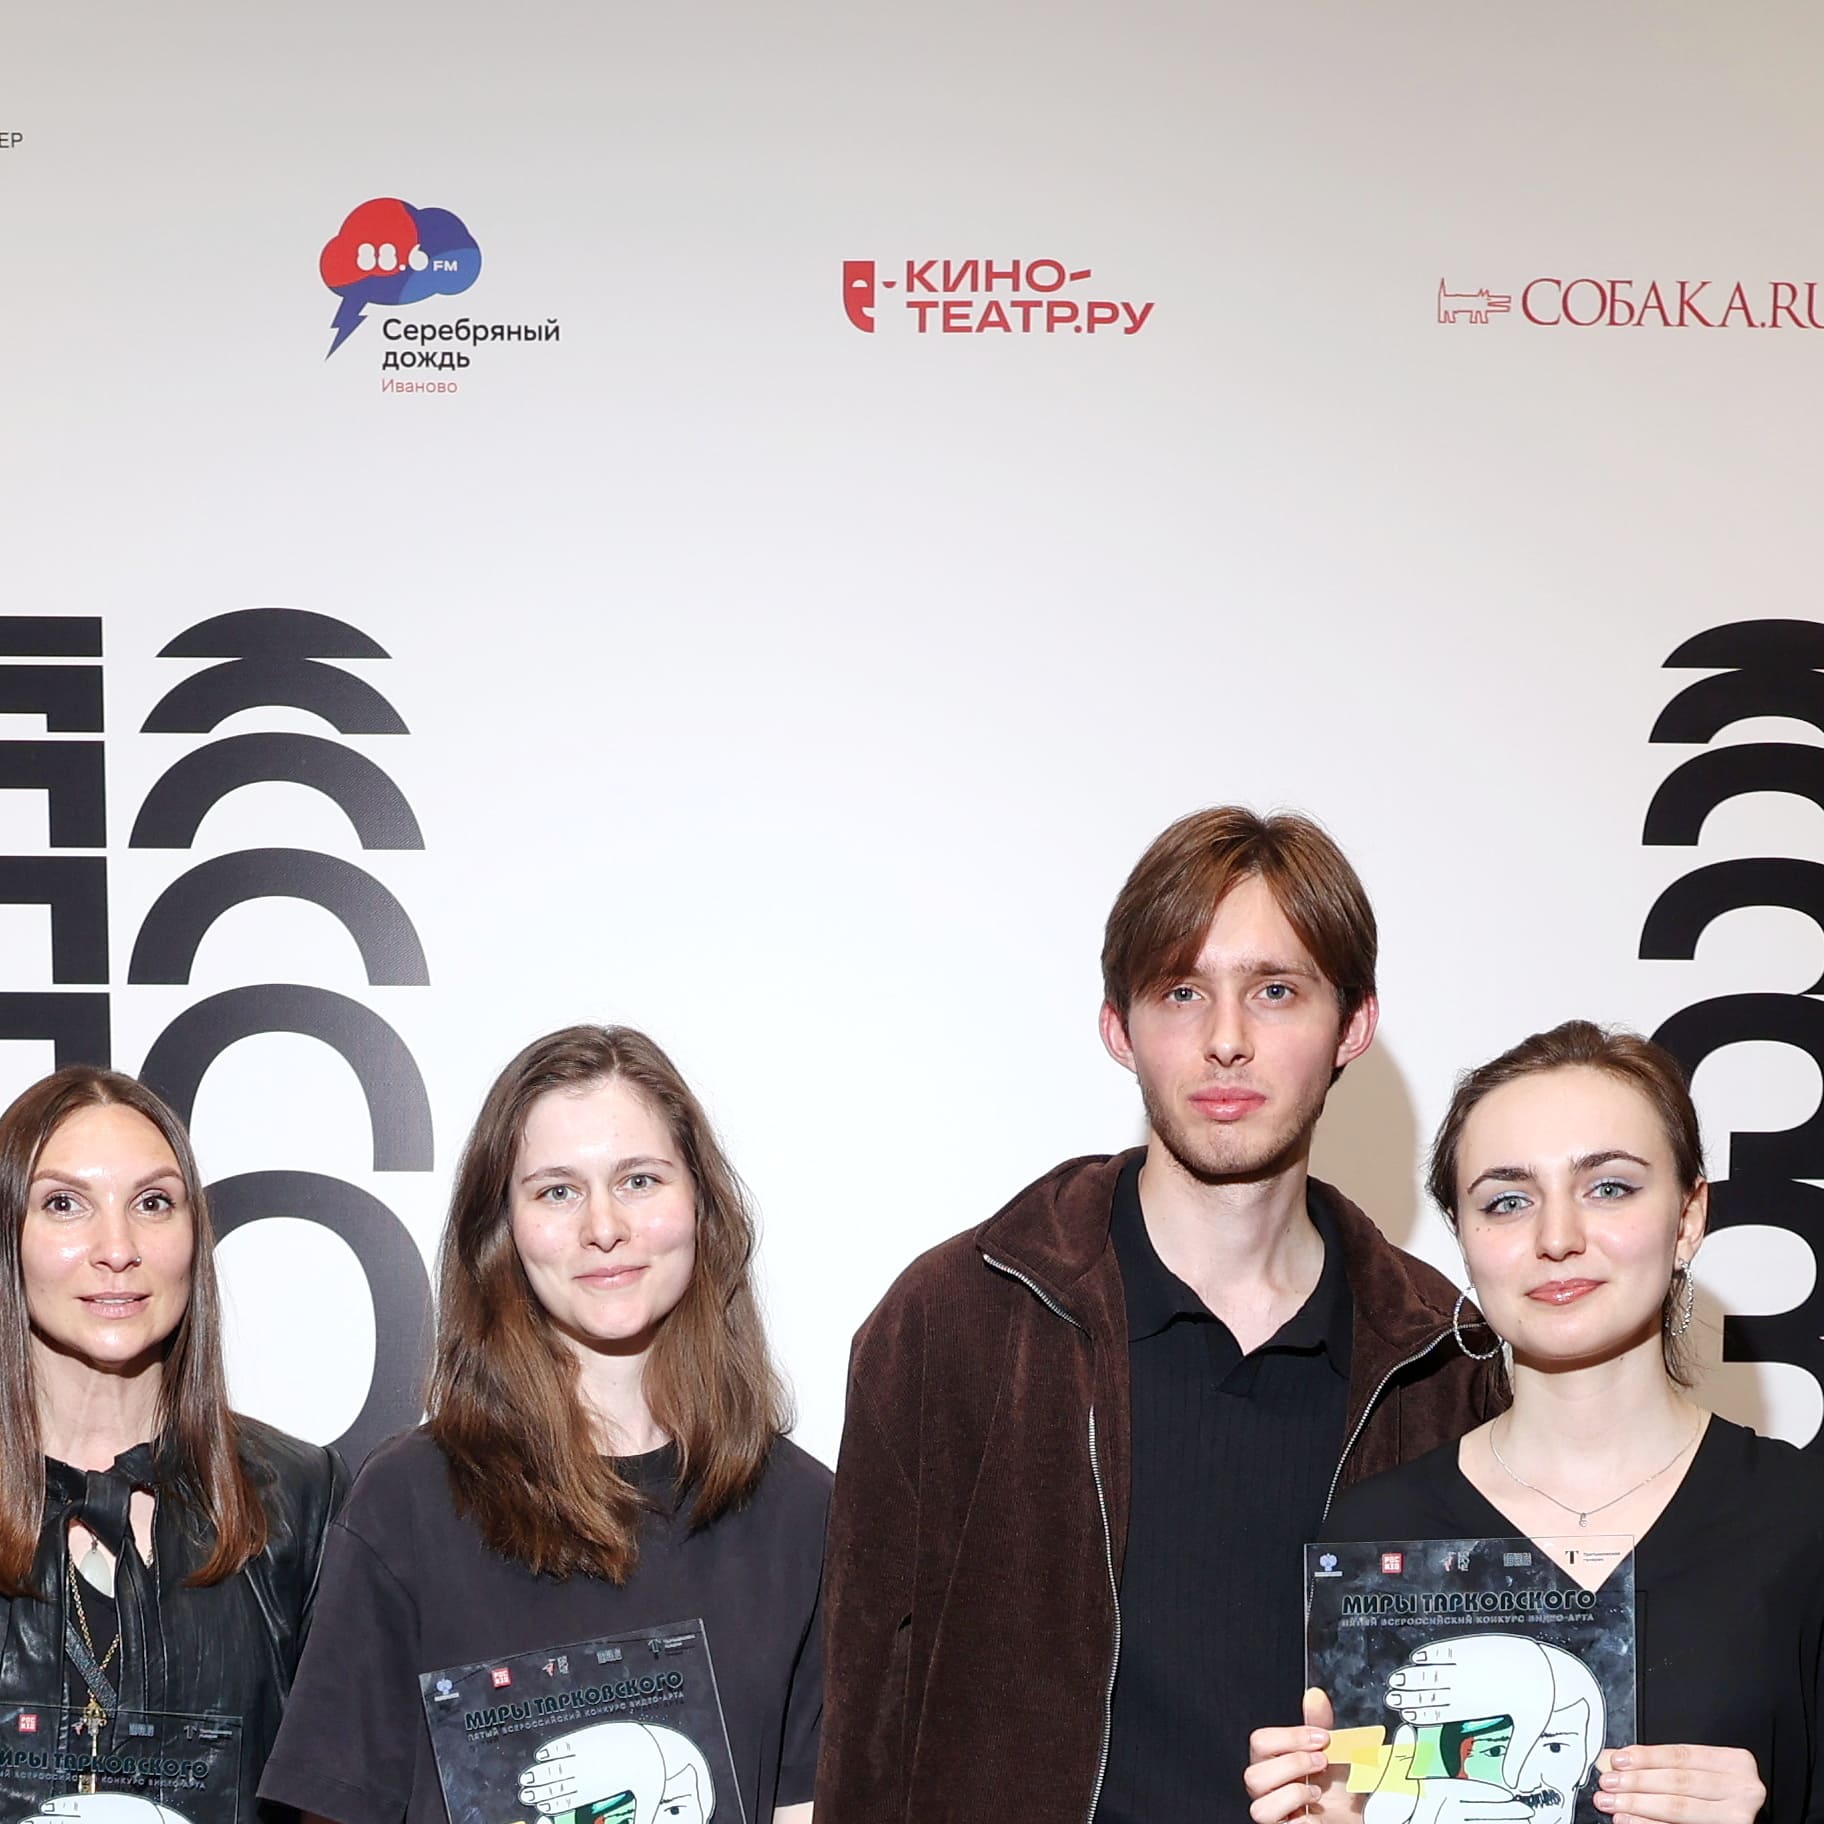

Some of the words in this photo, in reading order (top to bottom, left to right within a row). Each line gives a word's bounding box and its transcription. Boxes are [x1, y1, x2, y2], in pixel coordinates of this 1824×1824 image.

[357, 243, 429, 271] 88.6
[433, 260, 458, 272] FM
[905, 259, 1093, 293] КИНО-
[905, 300, 1155, 335] ТЕАТР.РУ
[382, 317, 561, 348] Серебряный
[381, 346, 470, 372] дождь
[381, 377, 458, 396] Иваново
[1342, 1594, 1417, 1615] МИРЫ
[1421, 1589, 1597, 1615] ТАРКОВСКОГО
[465, 1700, 532, 1732] МИРЫ
[534, 1670, 684, 1717] ТАРКОВСКОГО
[52, 1750, 208, 1778] ТАРКОВСКОГО
